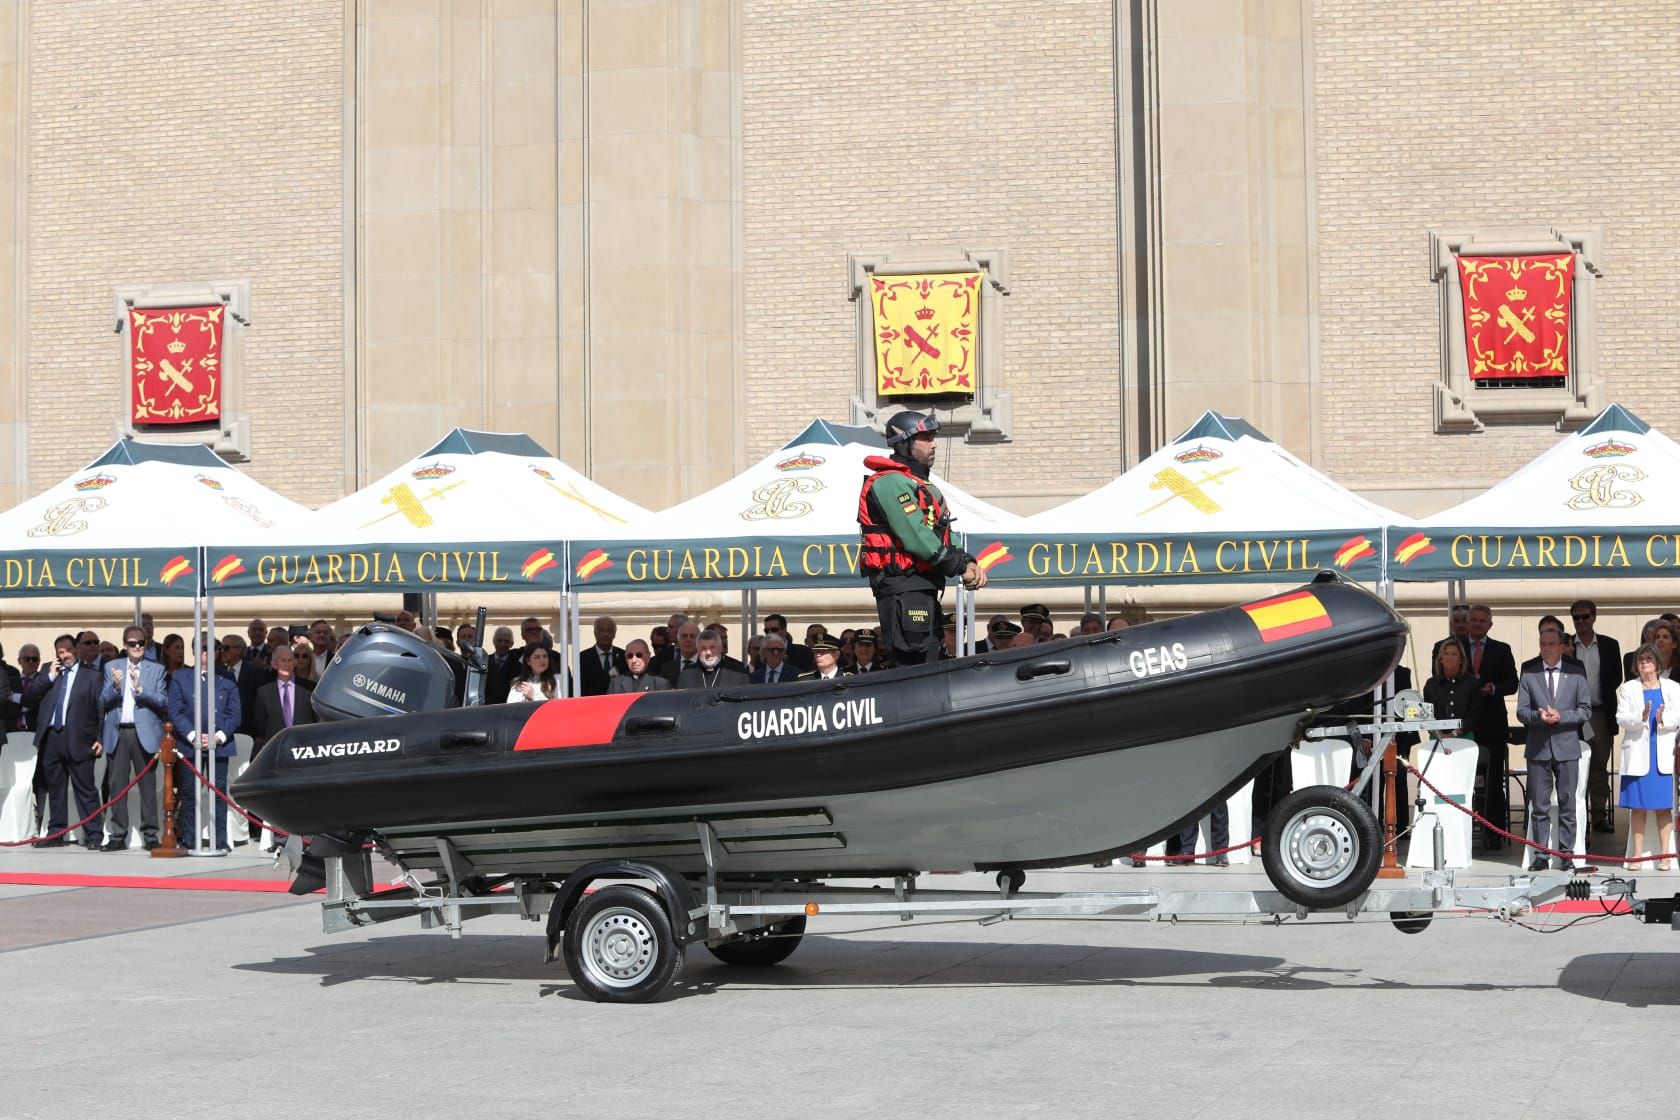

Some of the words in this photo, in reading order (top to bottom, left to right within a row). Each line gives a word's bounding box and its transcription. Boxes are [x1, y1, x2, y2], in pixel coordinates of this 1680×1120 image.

[257, 552, 405, 584] GUARDIA
[417, 551, 509, 582] CIVIL
[625, 545, 789, 581] GUARDIA
[1027, 541, 1200, 575] GUARDIA
[1215, 539, 1319, 572] CIVIL
[1451, 534, 1631, 568] GUARDIA
[0, 559, 56, 588] DIA
[66, 557, 148, 587] CIVIL
[1129, 642, 1188, 678] GEAS
[365, 678, 406, 704] YAMAHA
[737, 704, 827, 740] GUARDIA
[832, 697, 883, 730] CIVIL
[291, 738, 401, 760] VANGUARD
